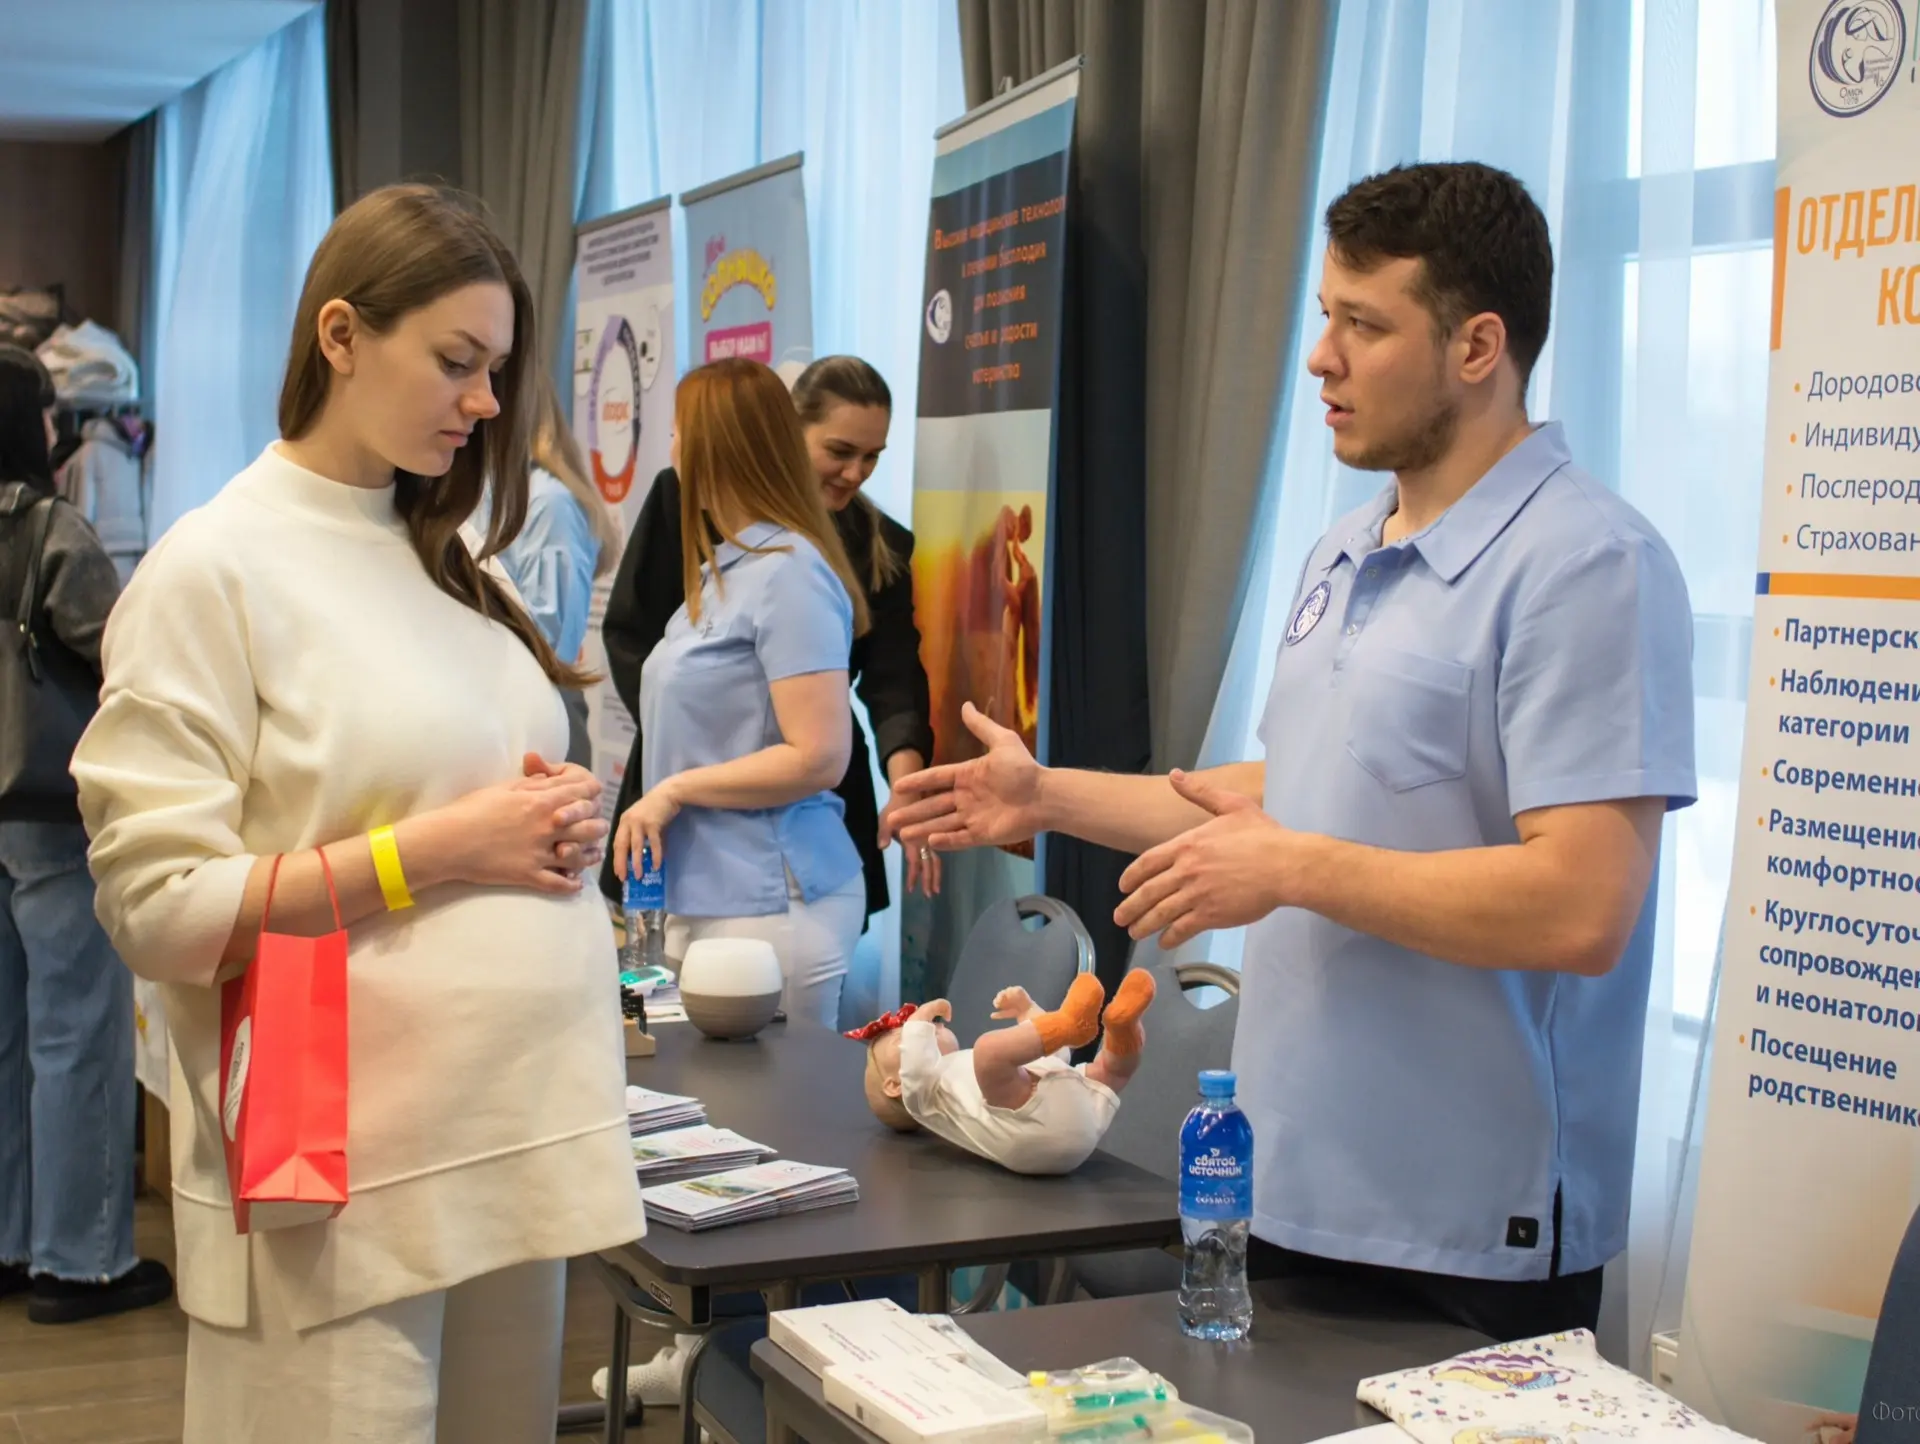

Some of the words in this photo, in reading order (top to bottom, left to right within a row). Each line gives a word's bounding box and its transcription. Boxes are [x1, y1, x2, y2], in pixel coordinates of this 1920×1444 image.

[1796, 184, 1920, 260] ОТДЕЛ
[1805, 422, 1920, 452] Индивиду
[1801, 473, 1920, 505] Послерод
[1797, 524, 1920, 556] Страхован
[1785, 618, 1920, 654] Партнерск
[1778, 714, 1909, 746] категории
[1773, 759, 1920, 797] Современн
[1769, 808, 1920, 850] Размещени
[1756, 984, 1770, 1004] и
[1751, 1028, 1897, 1080] Посещение
[1748, 1073, 1920, 1128] родственник
